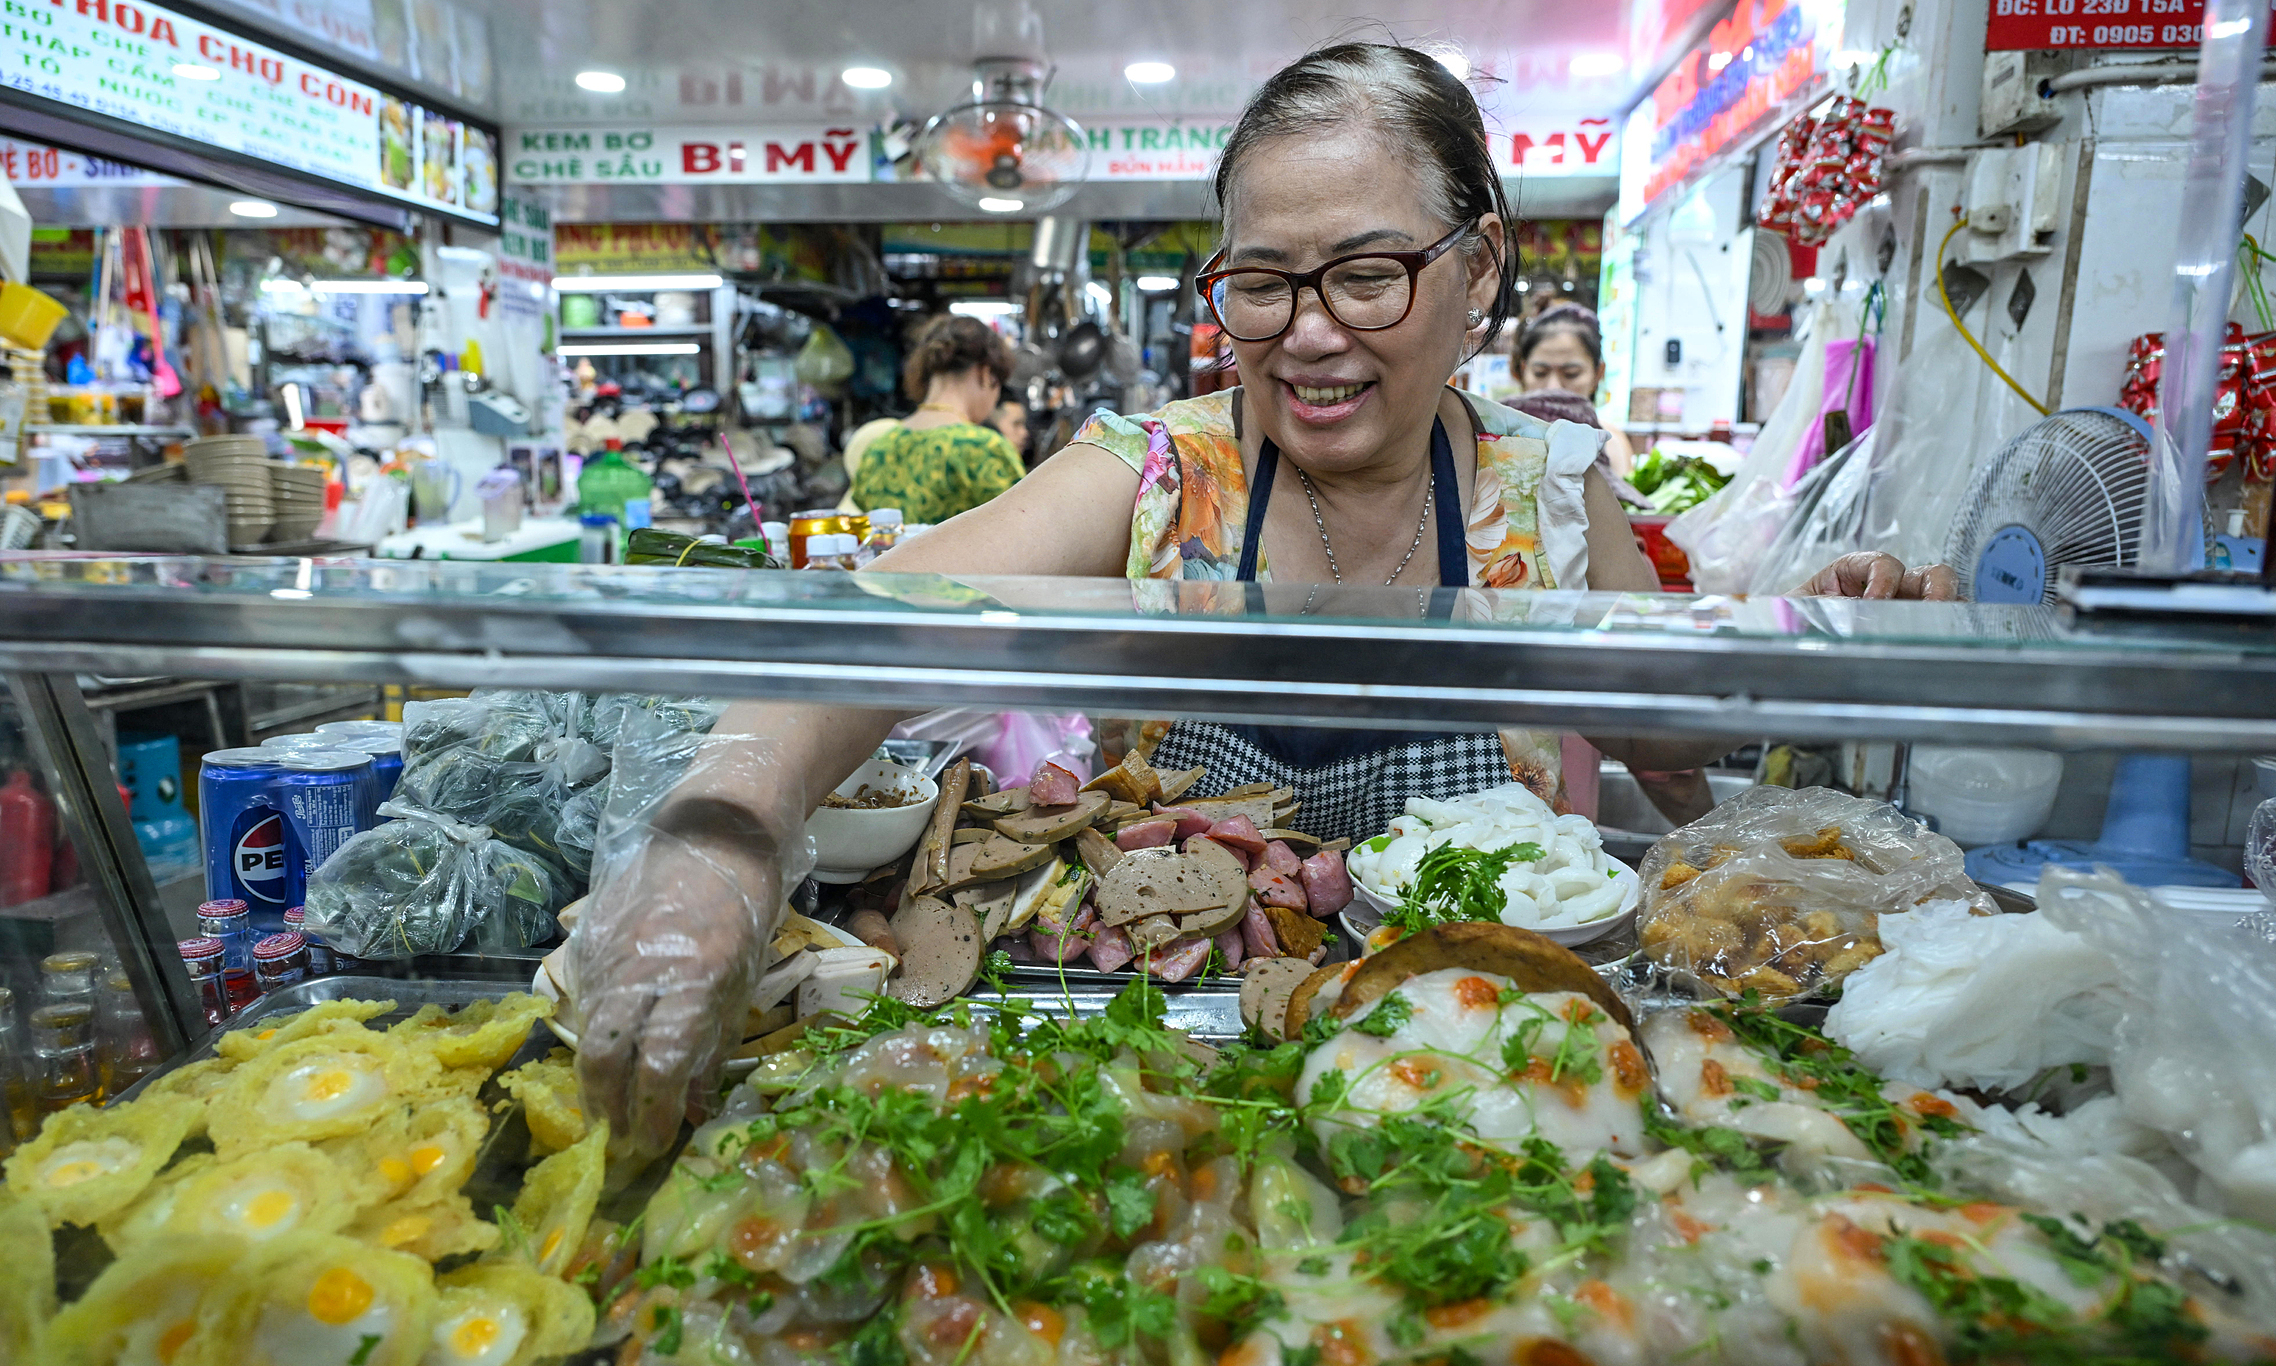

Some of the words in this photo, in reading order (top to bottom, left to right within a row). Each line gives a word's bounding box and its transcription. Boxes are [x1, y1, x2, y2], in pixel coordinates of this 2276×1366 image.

[50, 0, 179, 47] HOA
[2050, 26, 2086, 44] ĐT:
[2093, 25, 2154, 44] 0905
[521, 132, 591, 150] KEM
[605, 131, 653, 150] BƠ
[765, 129, 858, 172] MỸ
[1512, 118, 1611, 164] MỸ
[515, 155, 582, 178] CHÈ
